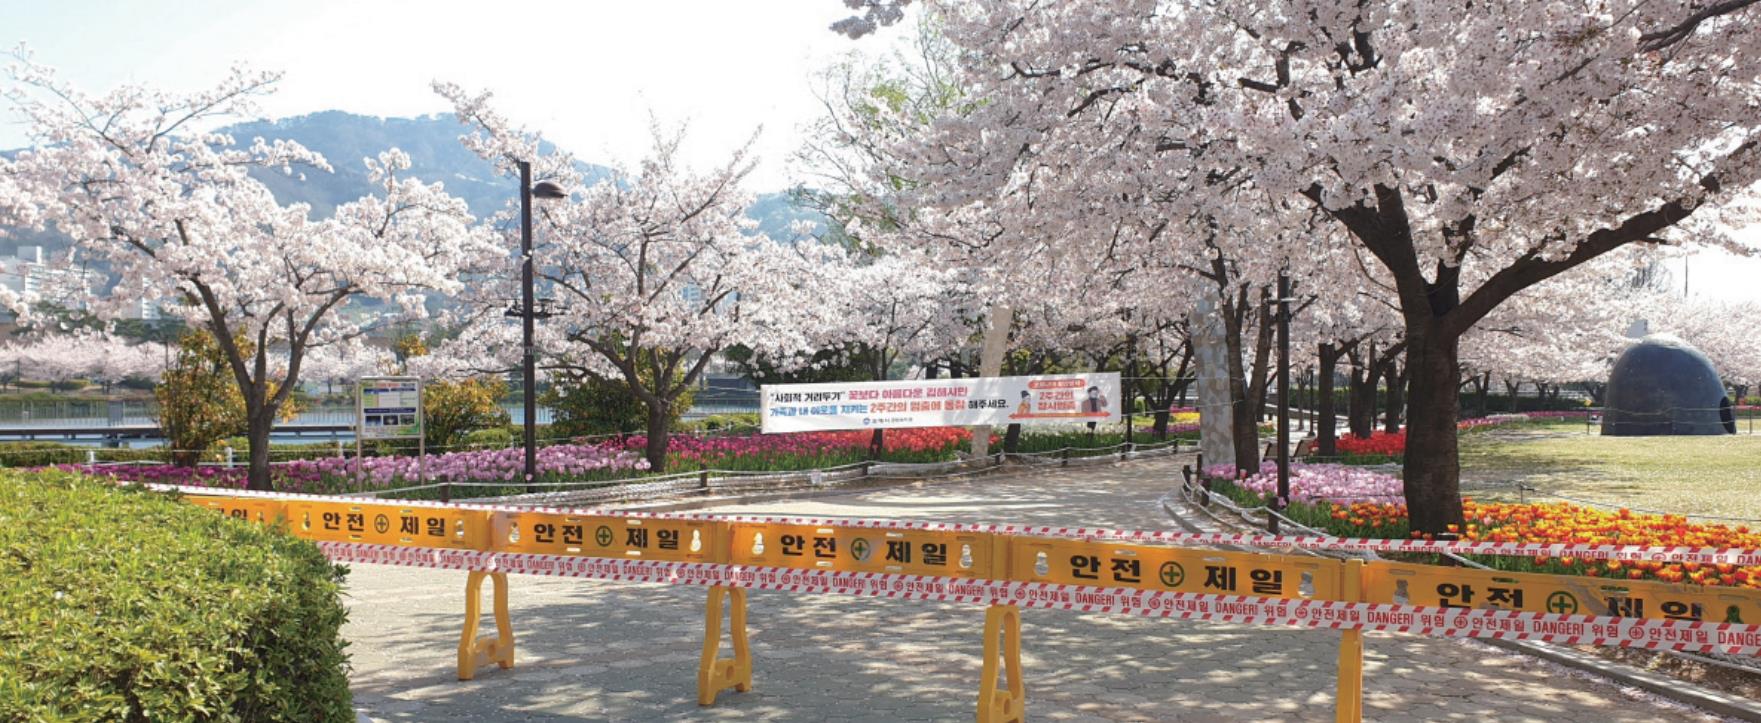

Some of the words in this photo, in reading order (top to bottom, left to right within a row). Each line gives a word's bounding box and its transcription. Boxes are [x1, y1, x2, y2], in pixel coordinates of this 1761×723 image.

[968, 398, 1009, 409] 해주세요.
[323, 512, 365, 532] 안전
[401, 515, 446, 537] 제일
[534, 523, 584, 545] 안전
[625, 528, 680, 550] 제일
[780, 534, 838, 559] 안전
[885, 540, 947, 566] 제일
[1070, 555, 1141, 583] 안전
[1203, 565, 1283, 595] 제일
[1310, 607, 1360, 622] 안전제일
[1420, 614, 1445, 629] 위험
[1471, 616, 1525, 632] 안전제일
[1591, 623, 1619, 639] 위험
[1649, 627, 1709, 644] 안전제일
